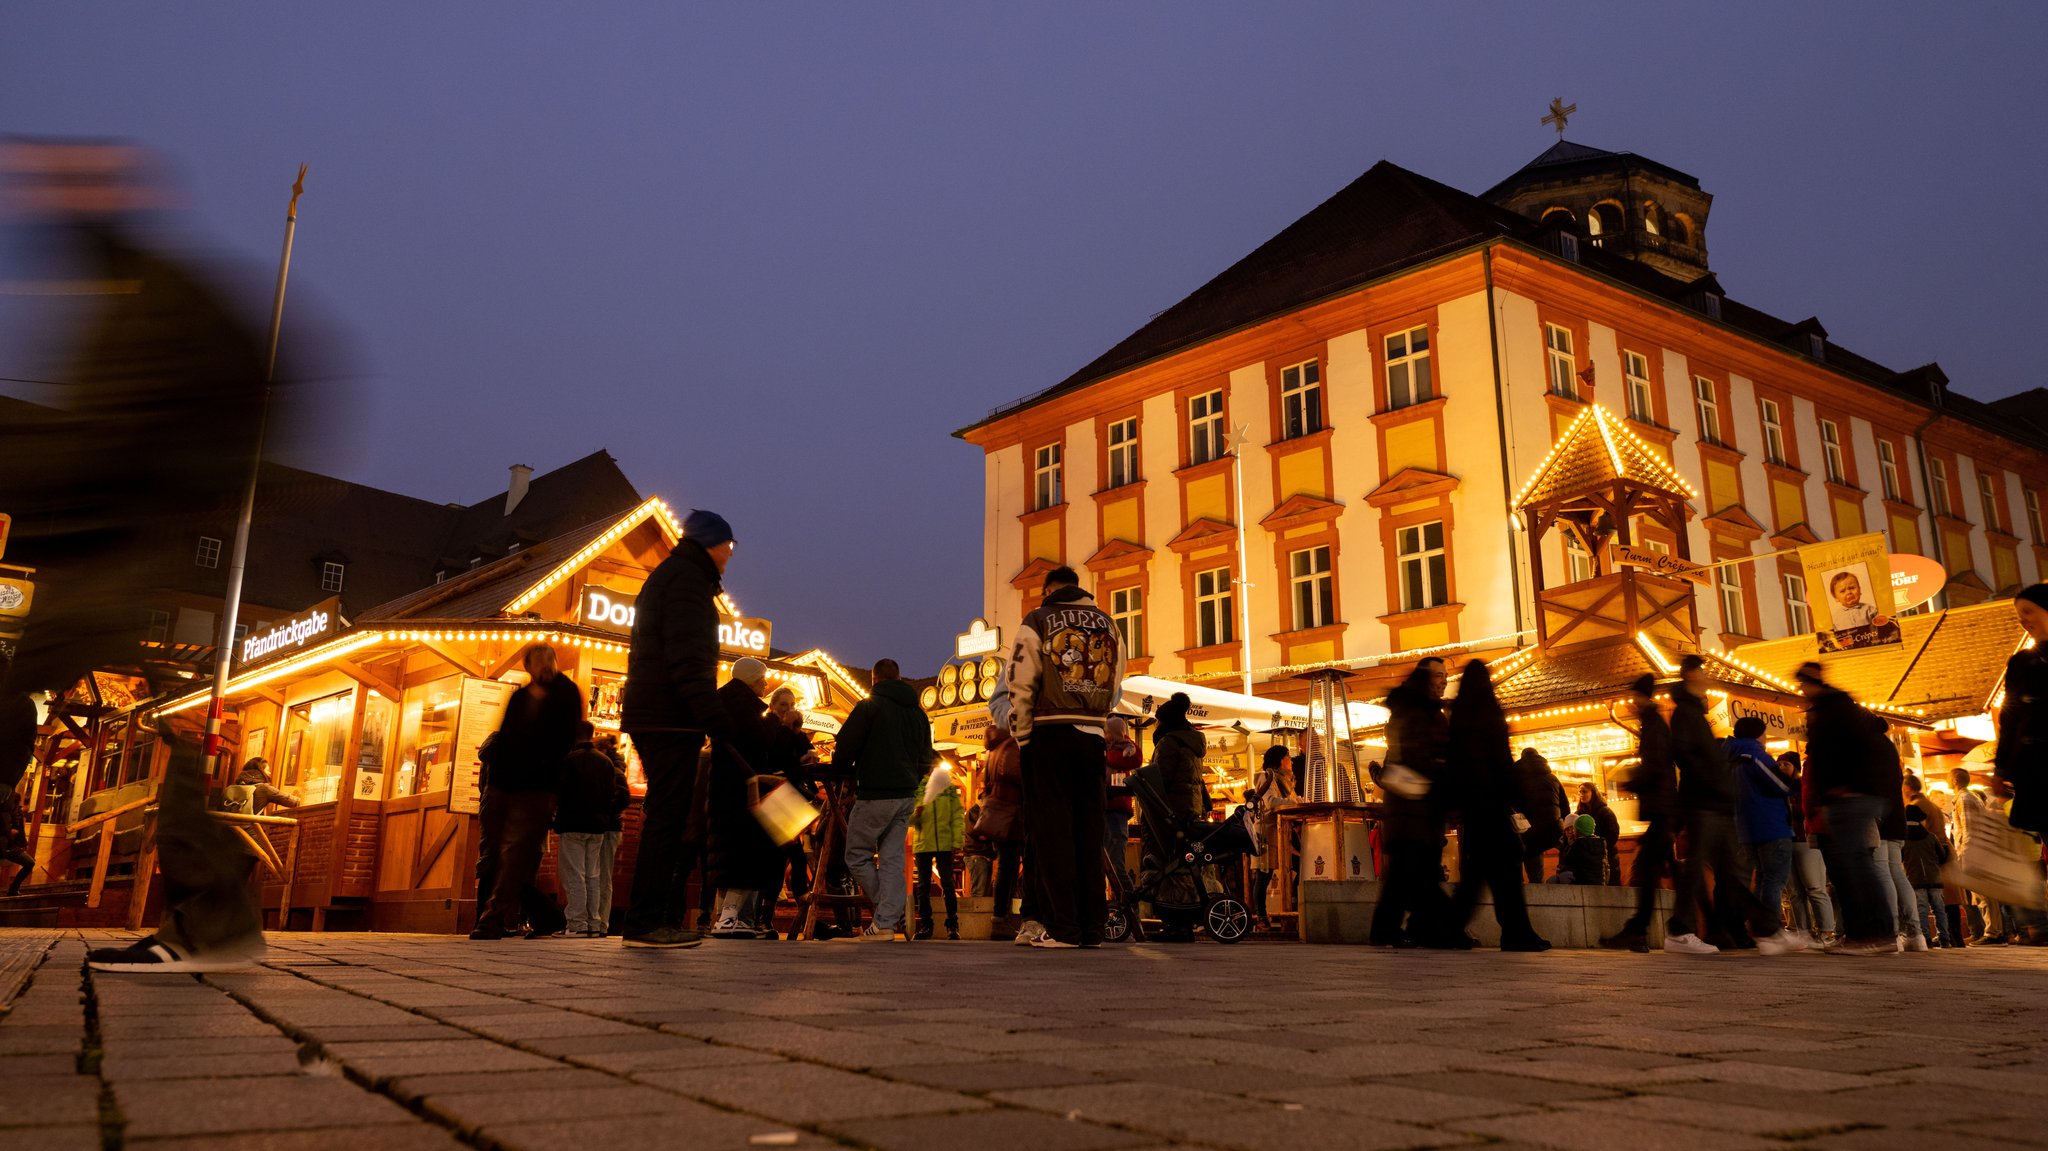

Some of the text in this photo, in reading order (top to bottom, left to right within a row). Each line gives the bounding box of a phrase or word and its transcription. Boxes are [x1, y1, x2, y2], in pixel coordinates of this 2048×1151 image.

[1620, 547, 1651, 564] Turm
[1806, 561, 1826, 571] Heute
[1847, 553, 1859, 564] gut
[1860, 544, 1883, 558] drauf?
[242, 610, 328, 662] Pfandrückgabe
